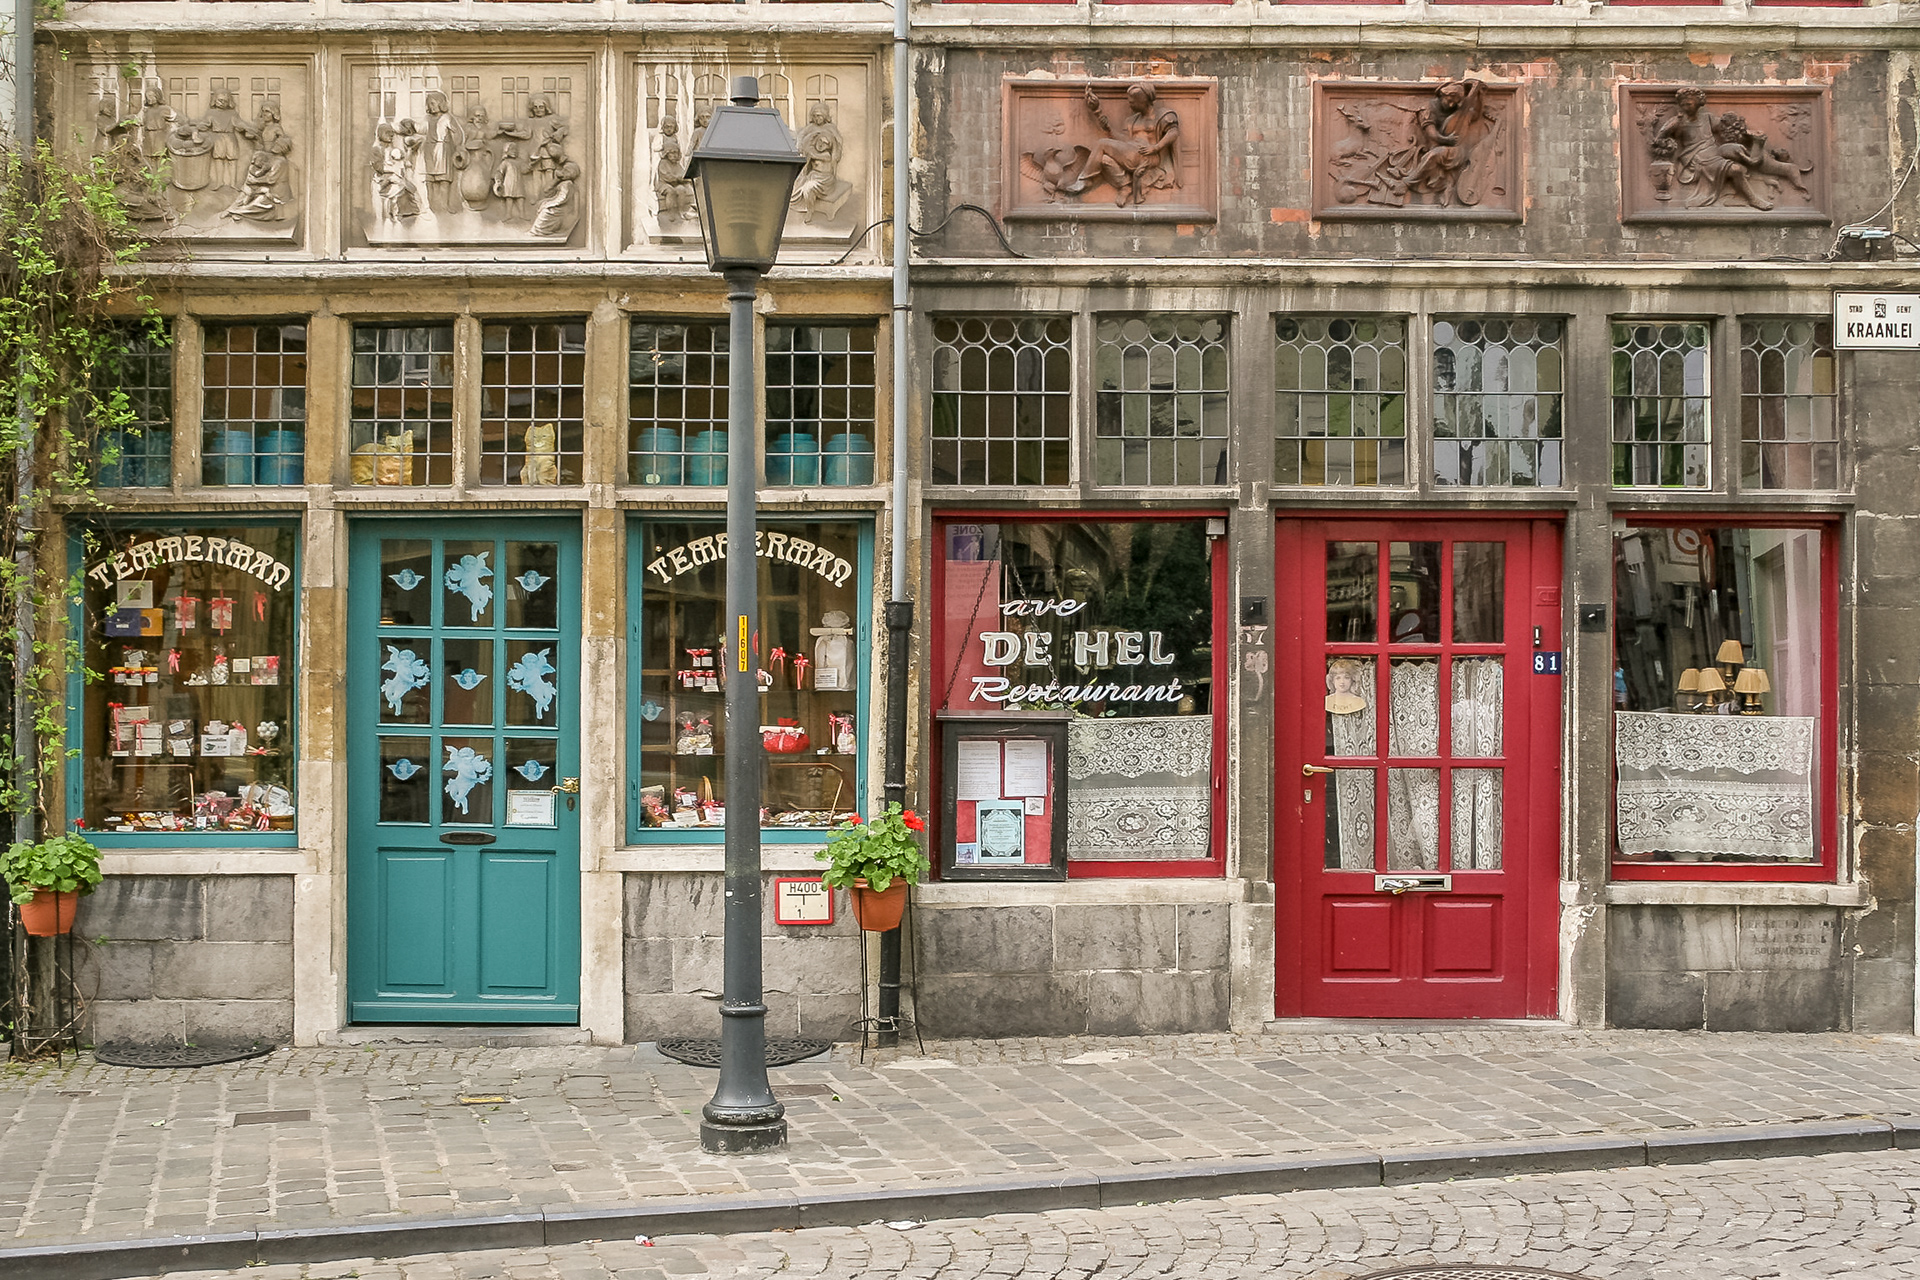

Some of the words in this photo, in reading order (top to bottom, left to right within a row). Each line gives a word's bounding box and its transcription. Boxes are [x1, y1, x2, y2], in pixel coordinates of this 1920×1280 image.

[1847, 322, 1912, 338] KRAANLEI
[88, 535, 291, 592] TEMMERMAN
[980, 631, 1052, 666] DE
[1073, 631, 1175, 666] HEL
[1534, 655, 1557, 671] 81
[968, 677, 1184, 702] Restaurant
